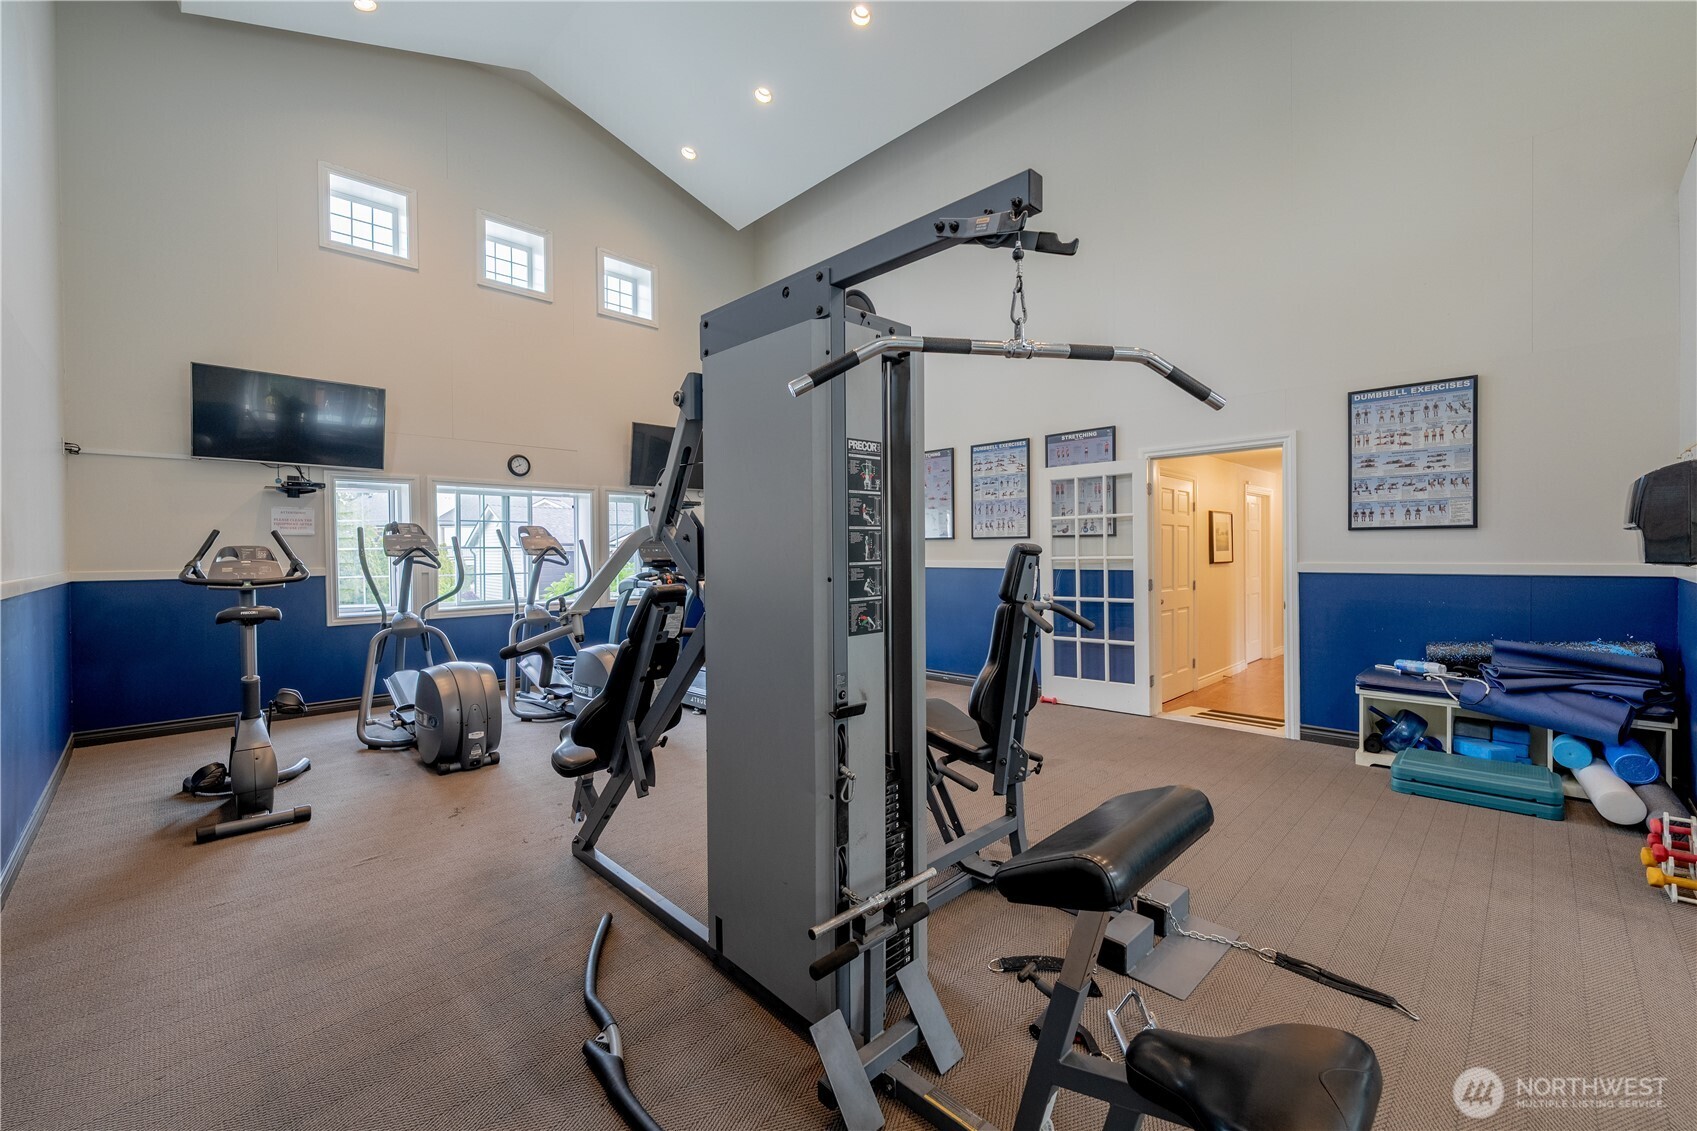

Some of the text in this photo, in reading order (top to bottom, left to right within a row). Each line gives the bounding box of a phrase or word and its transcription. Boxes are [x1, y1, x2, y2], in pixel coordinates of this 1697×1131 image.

[1354, 380, 1471, 402] DUMBBELL EXERCISES
[1061, 431, 1097, 441] STRETCHING
[848, 440, 877, 452] PRECOR
[999, 440, 1026, 449] EXERCISES
